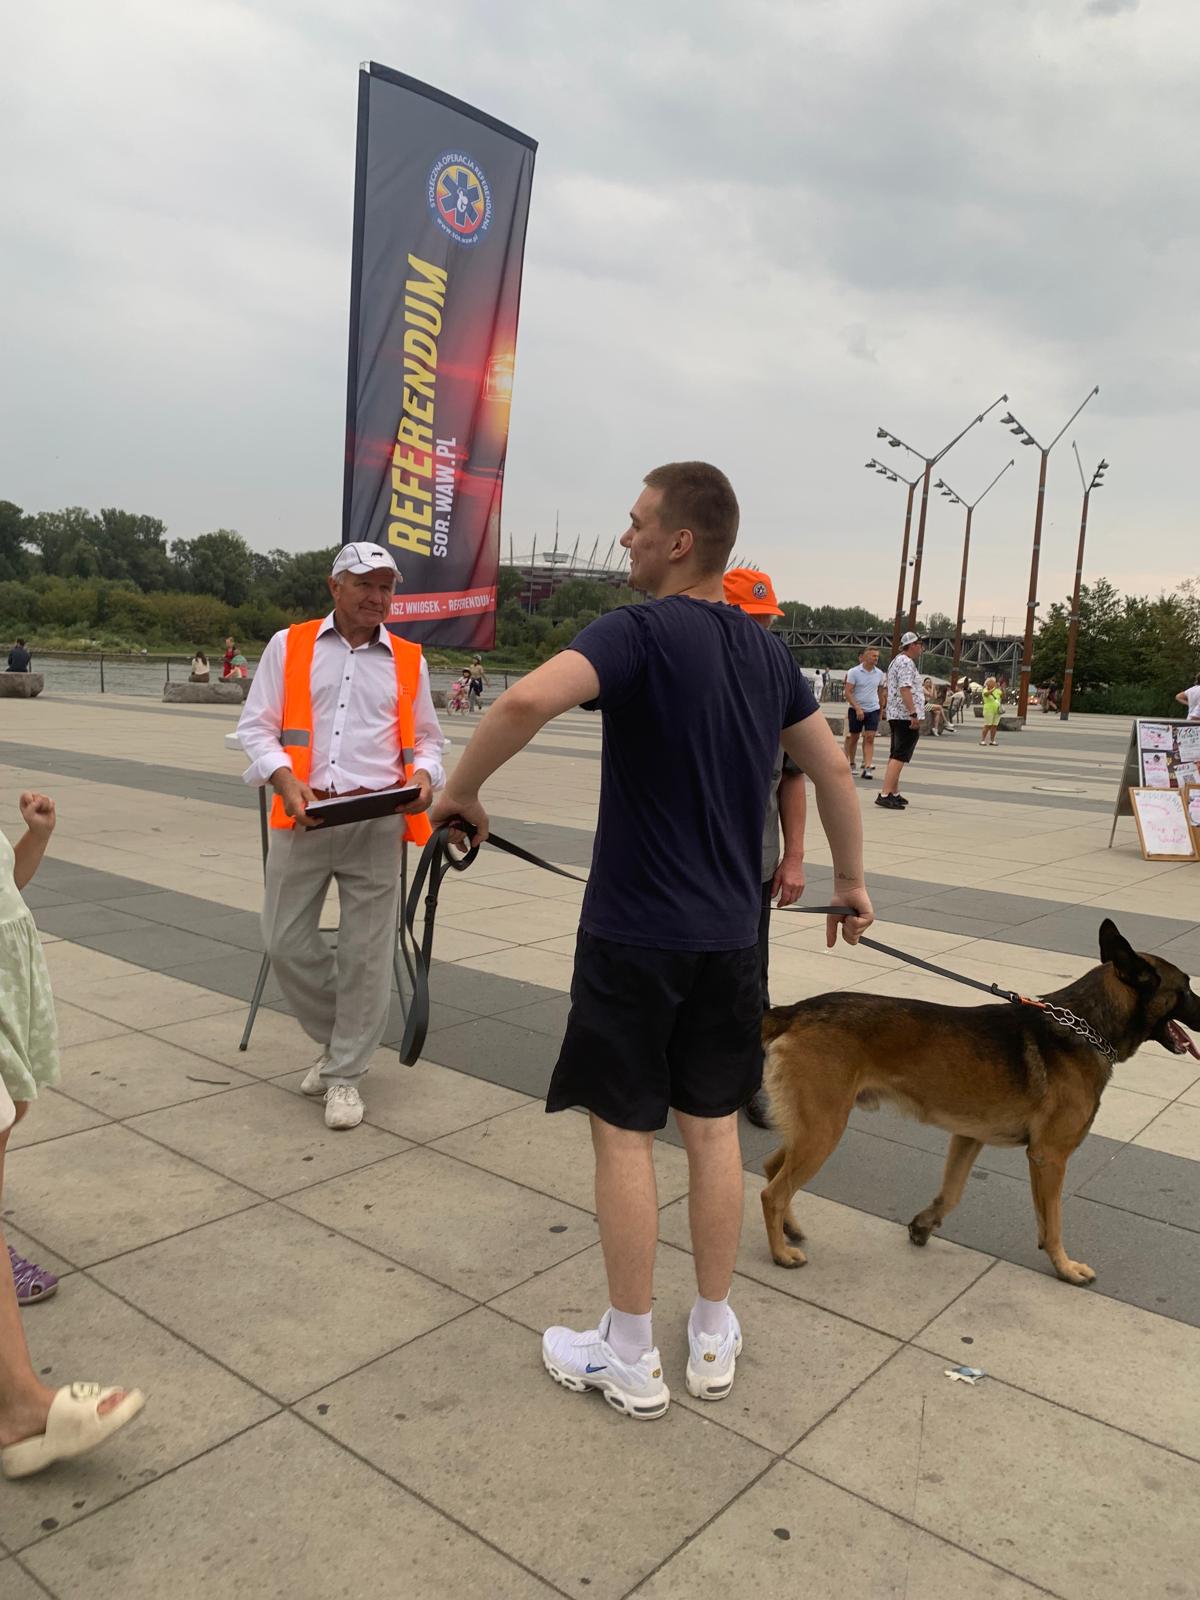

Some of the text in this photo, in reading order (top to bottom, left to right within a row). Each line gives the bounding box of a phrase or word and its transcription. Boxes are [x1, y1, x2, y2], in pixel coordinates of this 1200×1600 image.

[441, 153, 475, 170] OPERACJA
[473, 166, 492, 231] REFERENDALNA
[388, 253, 448, 557] REFERENDUM
[433, 437, 457, 558] SOR.WAW.PL
[390, 602, 405, 616] ISZ
[405, 600, 440, 615] WNIOSEK
